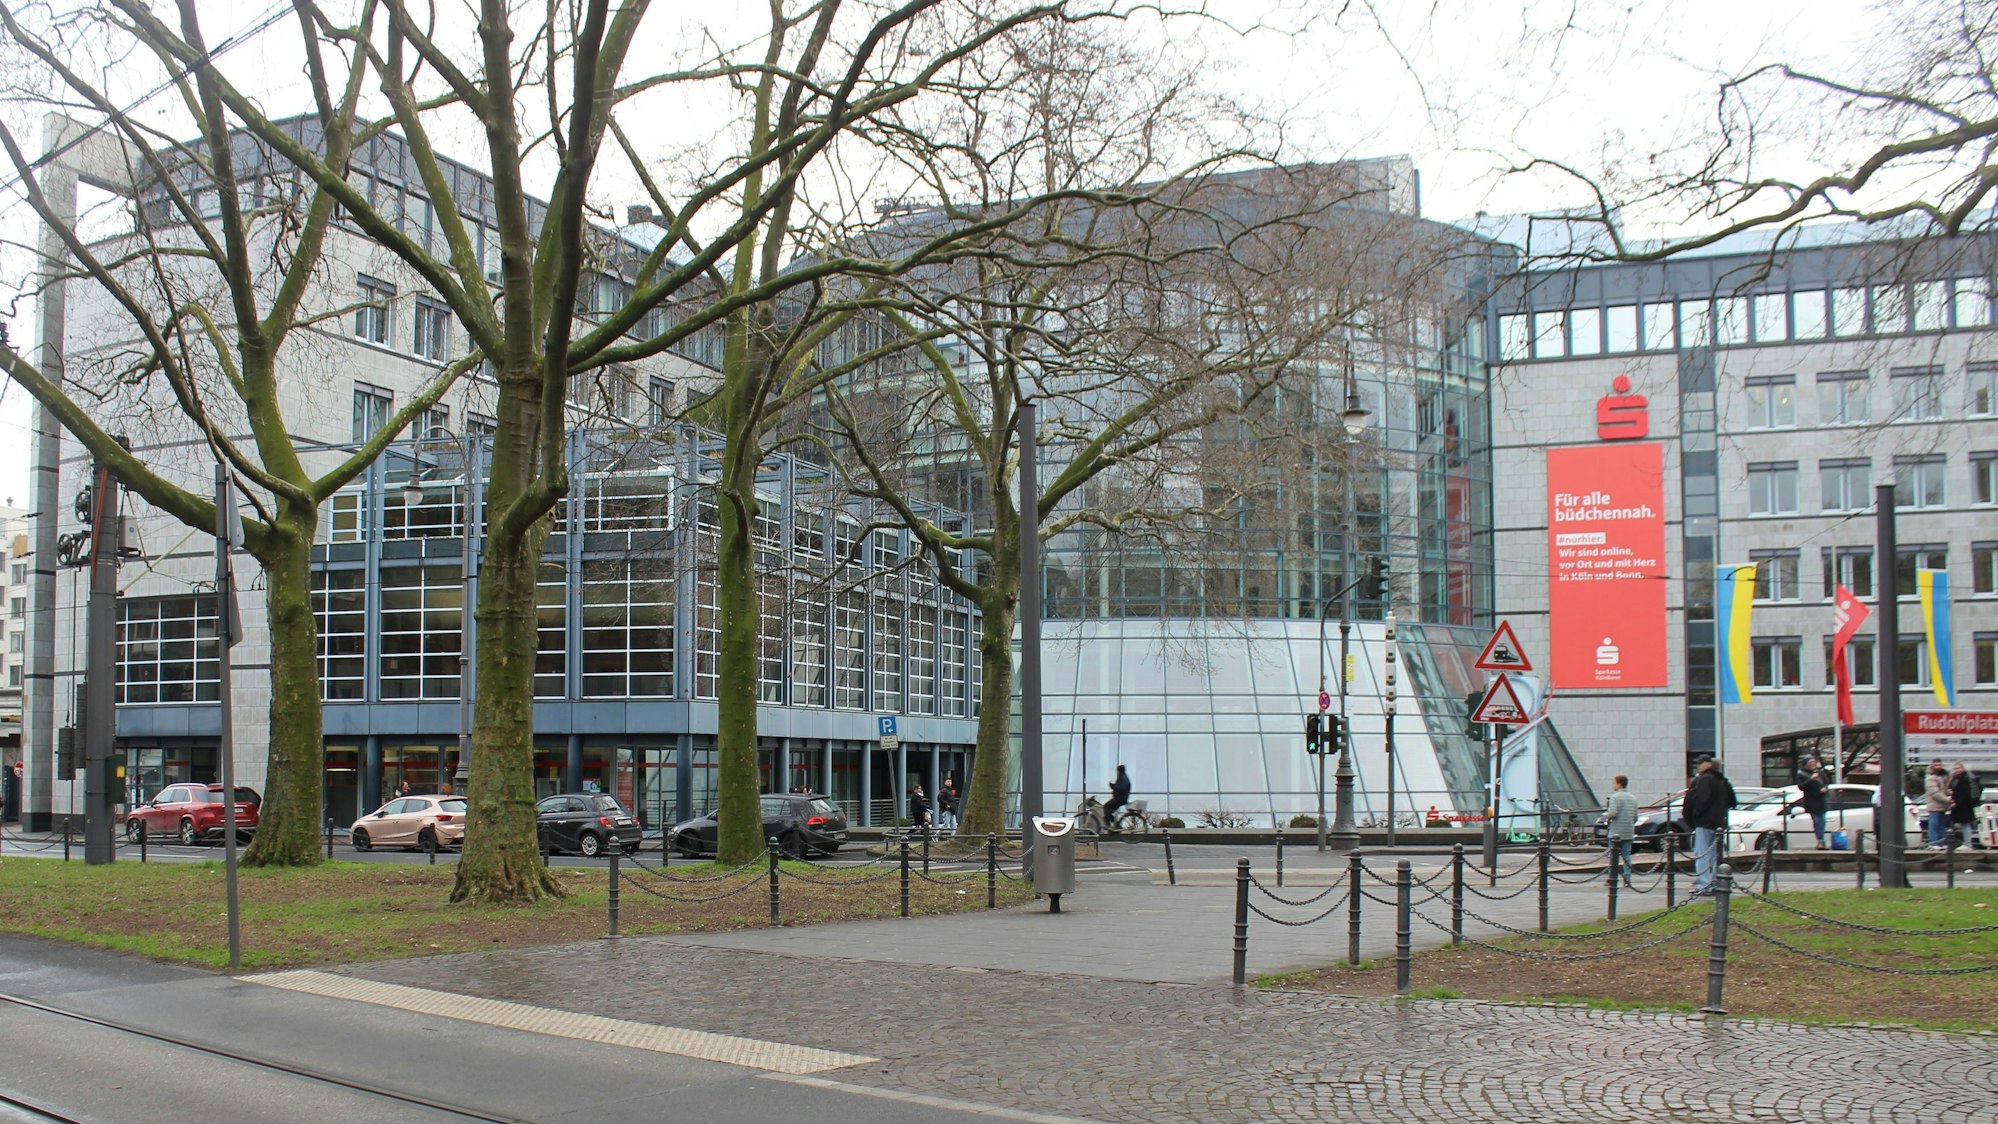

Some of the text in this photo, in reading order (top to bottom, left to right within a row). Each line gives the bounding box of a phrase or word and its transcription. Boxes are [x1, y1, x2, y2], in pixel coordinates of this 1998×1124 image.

[1555, 491, 1611, 507] Für alle
[1555, 504, 1656, 522] büdchennah.
[1559, 547, 1634, 557] Wir sind online,
[1560, 558, 1657, 570] vor Ort und mit Herz
[1560, 570, 1645, 582] in Köln und Bonn.
[882, 719, 892, 733] P
[1918, 715, 1998, 733] Rudolfplatz
